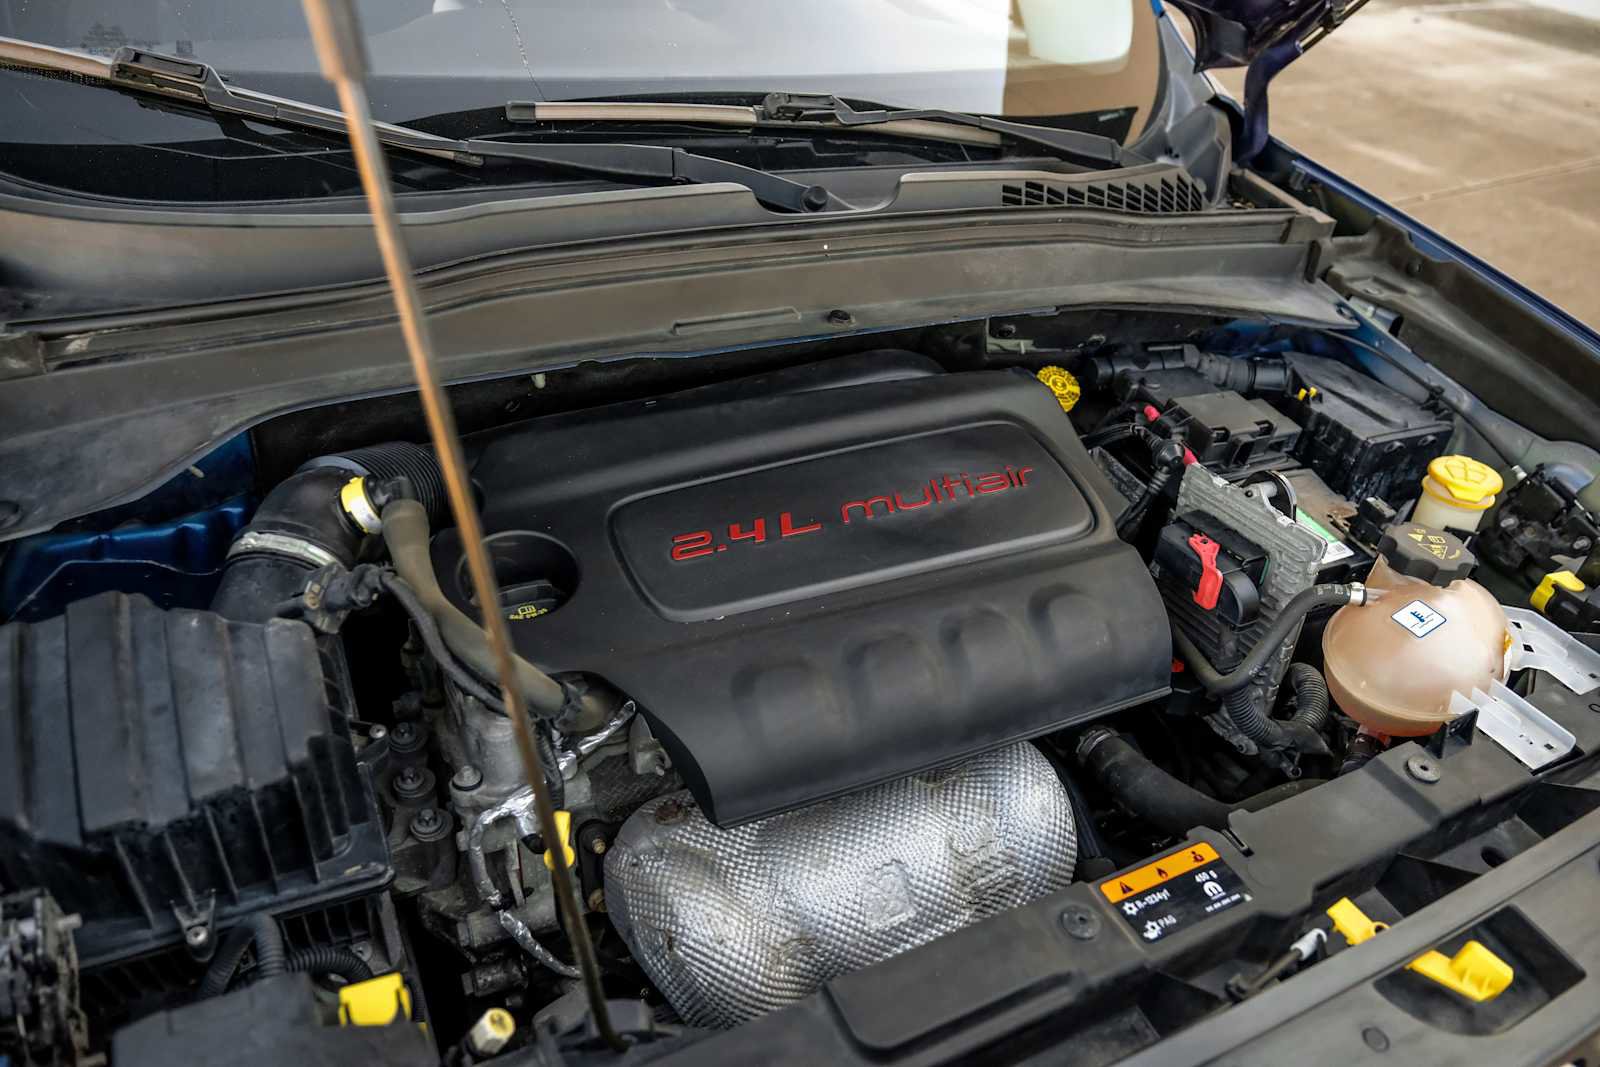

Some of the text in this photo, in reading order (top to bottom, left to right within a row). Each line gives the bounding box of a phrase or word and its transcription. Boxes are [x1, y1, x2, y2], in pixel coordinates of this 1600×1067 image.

[671, 465, 1034, 561] 2.4 L multiair
